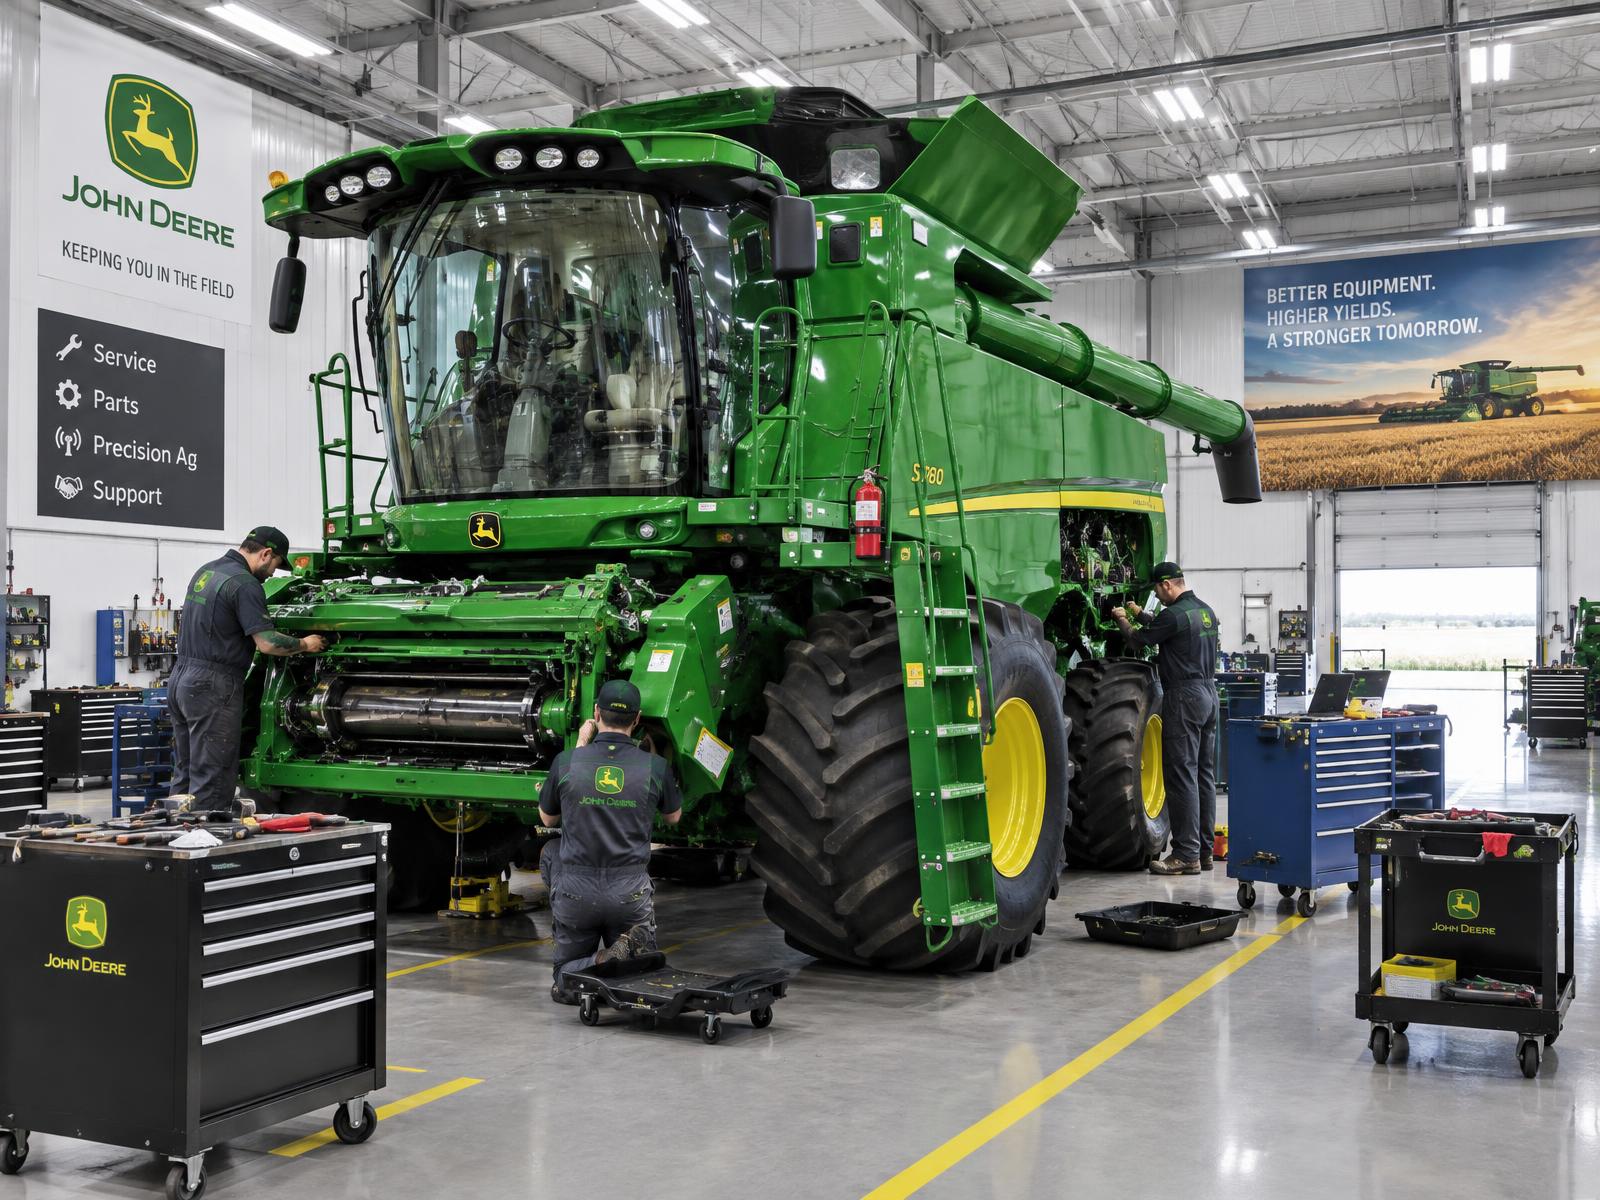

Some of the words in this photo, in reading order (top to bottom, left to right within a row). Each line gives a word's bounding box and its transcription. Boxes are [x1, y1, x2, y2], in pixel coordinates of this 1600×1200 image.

[62, 175, 143, 222] JOHN
[150, 198, 235, 249] DEERE
[62, 240, 122, 271] KEEPING
[126, 256, 153, 279] YOU
[157, 265, 170, 283] IN
[173, 269, 198, 290] THE
[201, 277, 234, 299] FIELD
[1267, 284, 1328, 304] BETTER
[1333, 274, 1436, 299] EQUIPMENT.
[1267, 306, 1328, 326] HIGHER
[1333, 301, 1396, 321] YIELDS.
[1267, 333, 1278, 349] A
[1283, 327, 1371, 347] STRONGER
[1376, 317, 1483, 340] TOMORROW.
[93, 343, 157, 374] Service
[93, 389, 139, 415] Parts
[93, 434, 171, 463] Precision
[176, 446, 198, 471] Ag
[93, 480, 163, 507] Support
[1432, 922, 1459, 932] JOHN
[1460, 923, 1496, 935] DEERE
[44, 953, 79, 970] JOHN
[82, 957, 126, 976] DEERE
